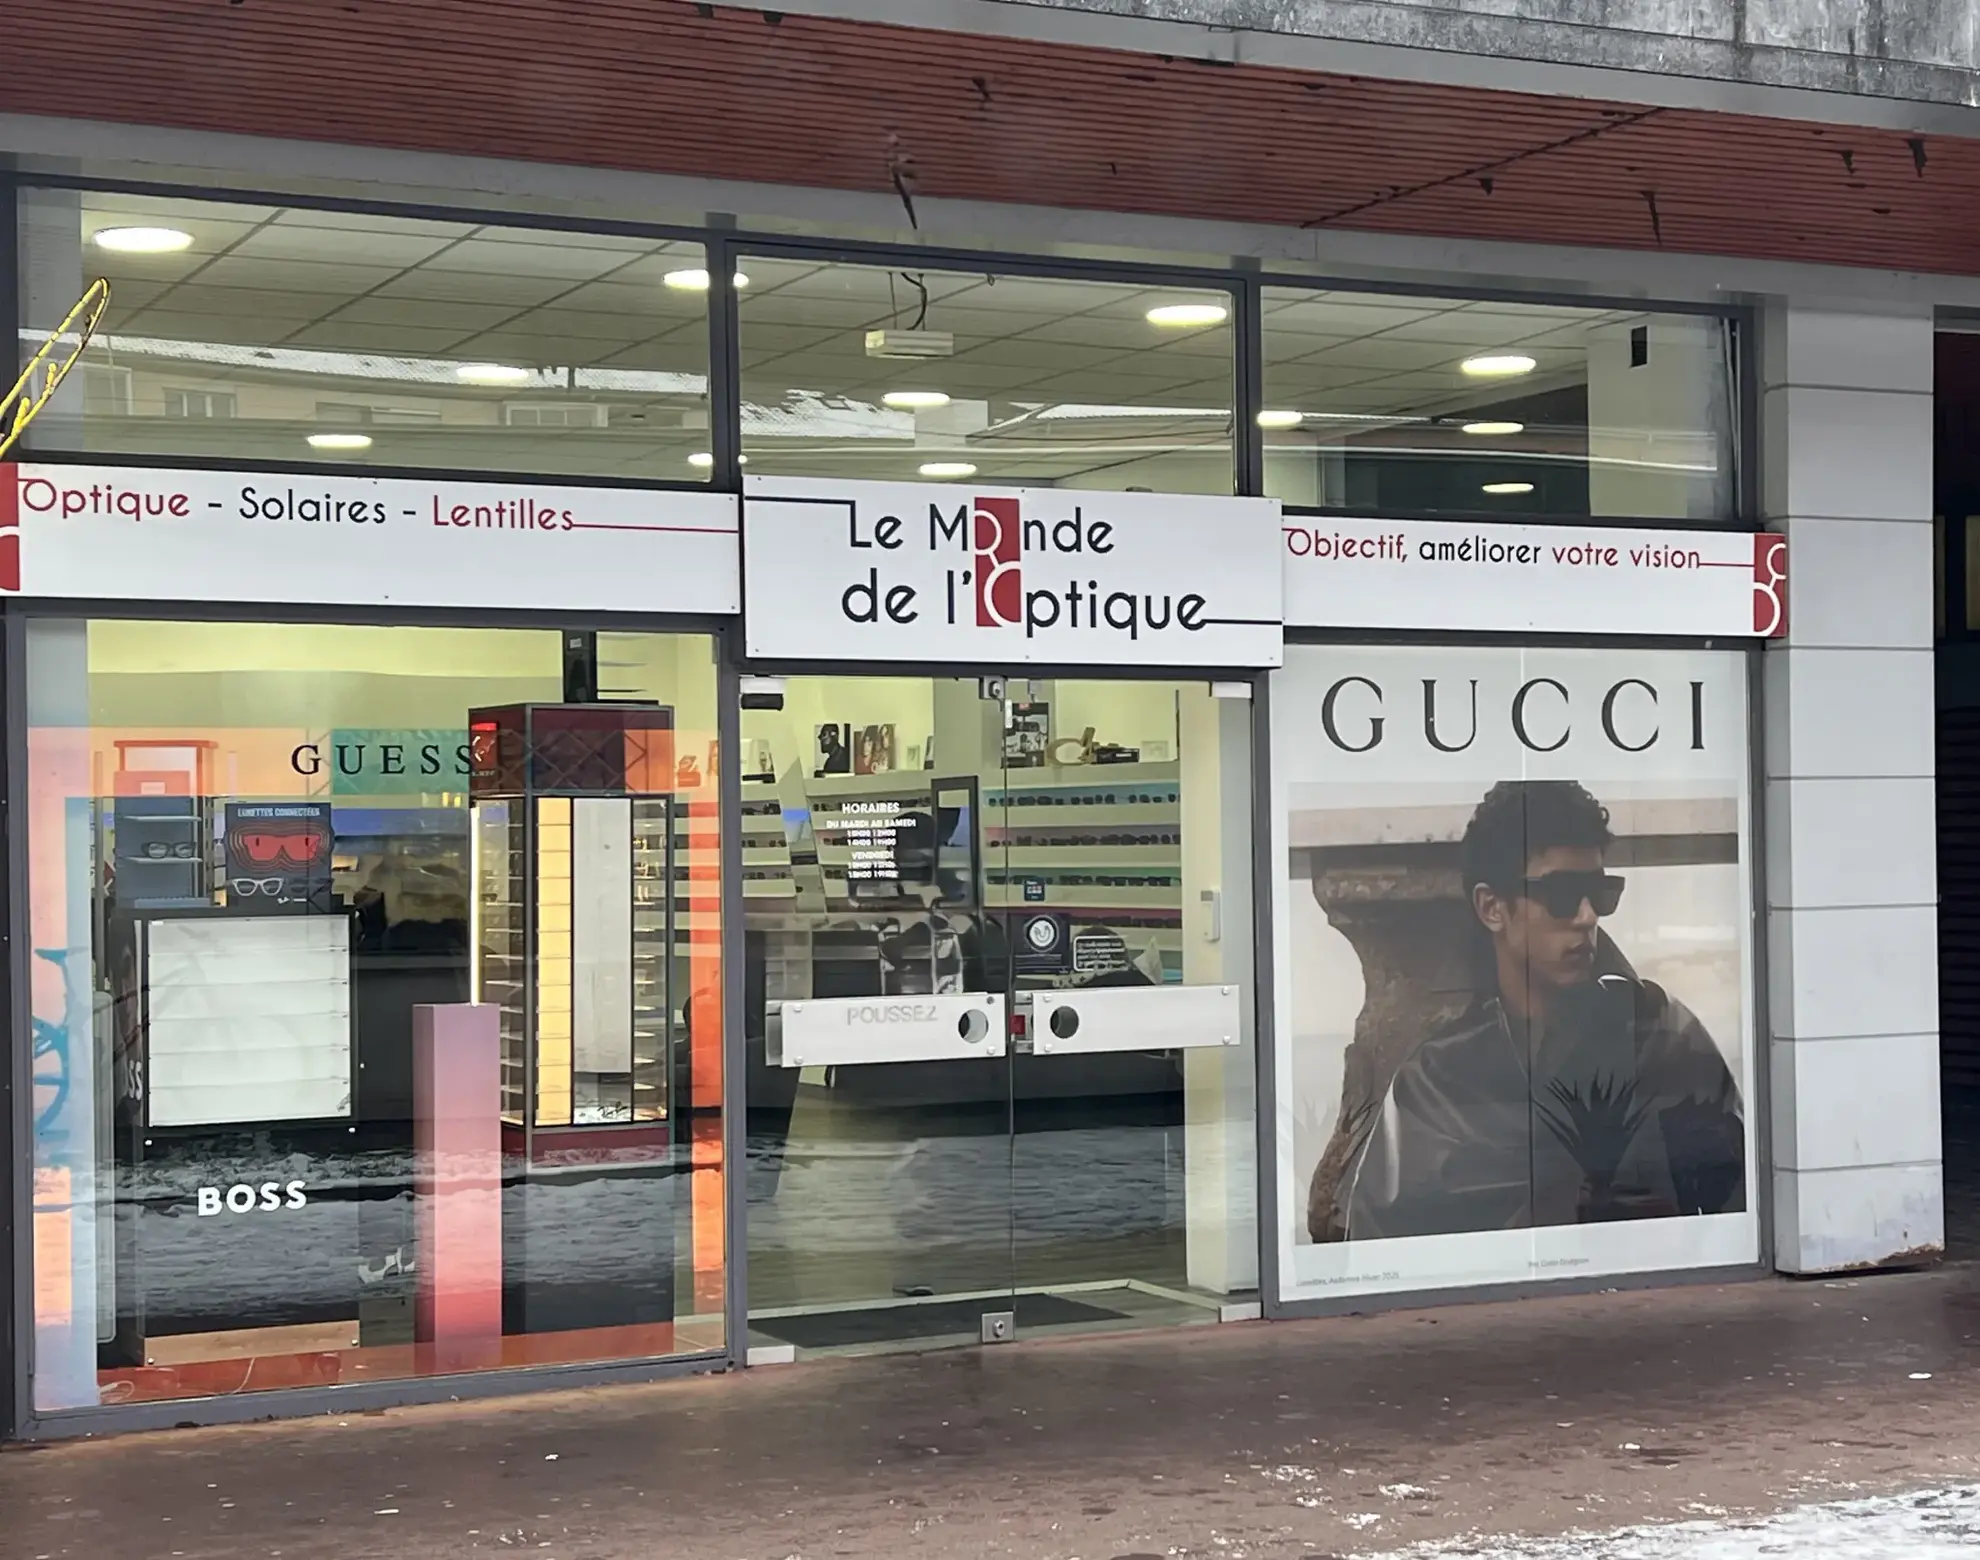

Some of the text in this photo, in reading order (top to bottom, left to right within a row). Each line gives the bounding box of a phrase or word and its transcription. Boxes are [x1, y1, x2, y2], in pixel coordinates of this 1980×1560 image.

[21, 478, 190, 520] Optique
[239, 486, 386, 525] Solaires
[433, 495, 575, 532] Lentilles
[850, 500, 1115, 556] Le Monde
[1287, 529, 1700, 569] Objectif, améliorer votre vision
[842, 567, 918, 624] de
[1321, 676, 1705, 752] GUCCI
[291, 744, 474, 776] GUESS
[826, 820, 839, 829] DU
[884, 819, 916, 828] SAMEDI
[841, 802, 900, 814] HORAIRES
[847, 1005, 939, 1026] POUSSEZ
[198, 1180, 307, 1216] BOSS
